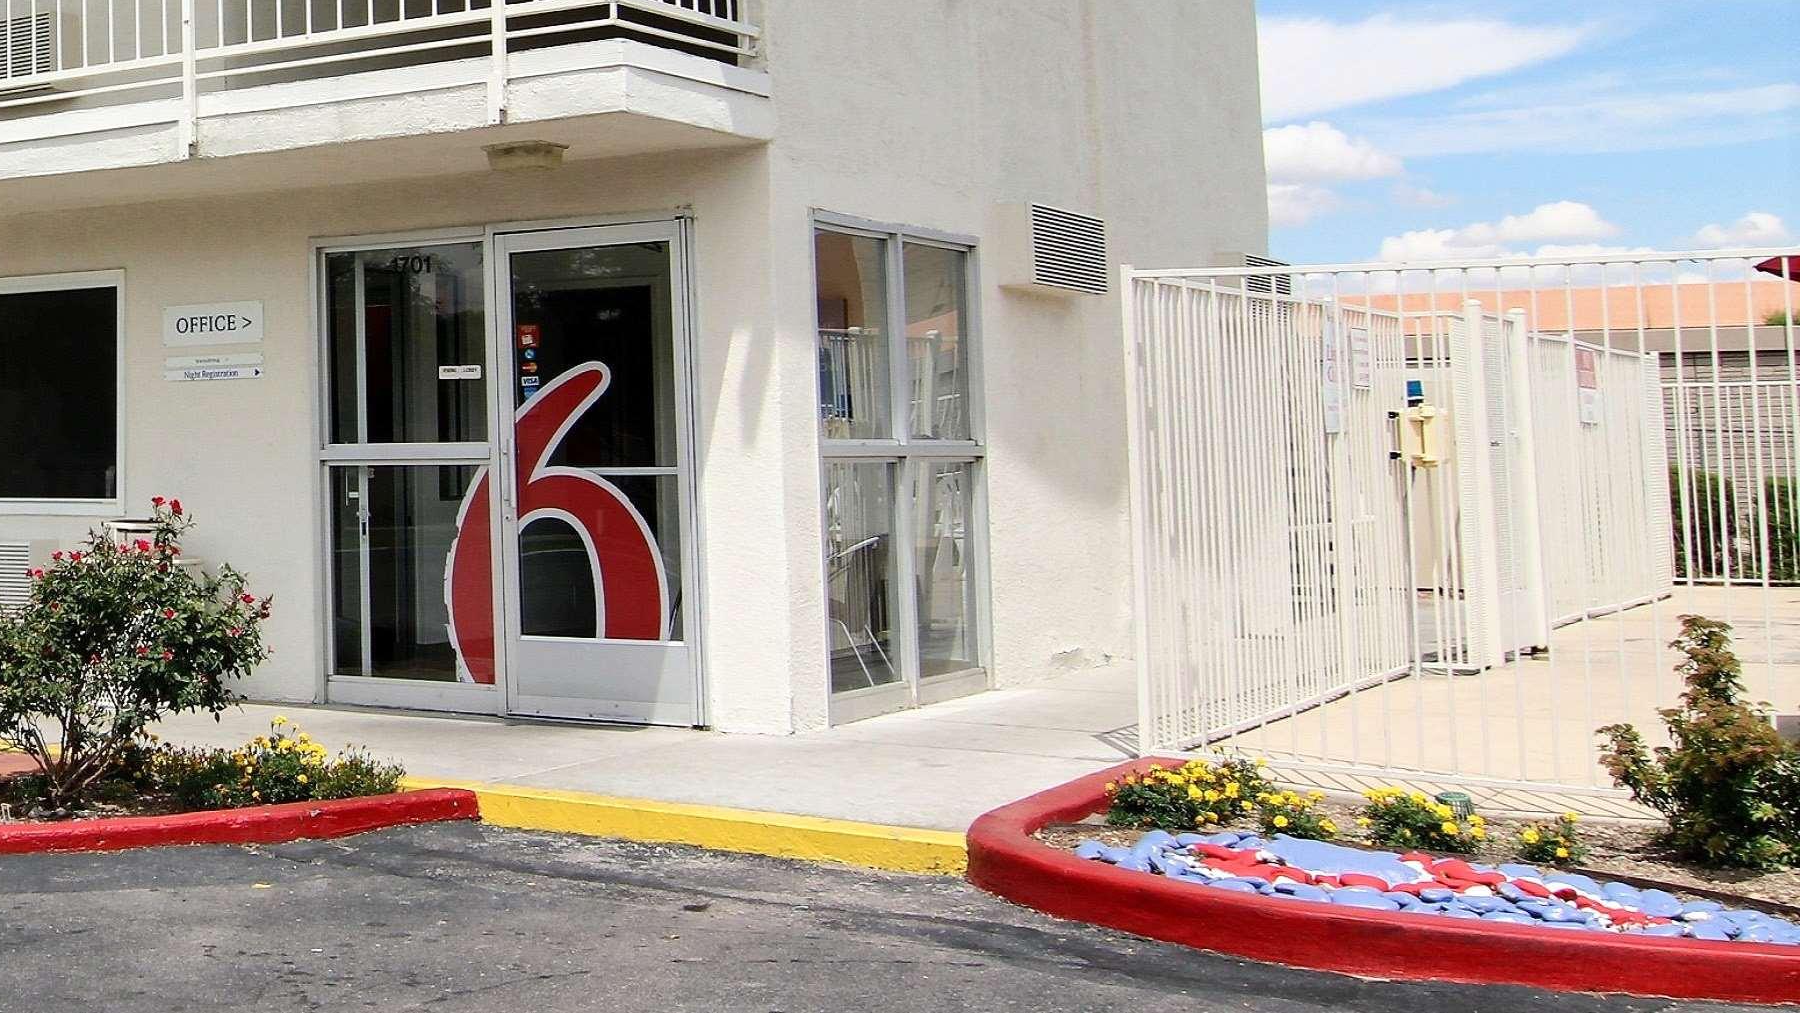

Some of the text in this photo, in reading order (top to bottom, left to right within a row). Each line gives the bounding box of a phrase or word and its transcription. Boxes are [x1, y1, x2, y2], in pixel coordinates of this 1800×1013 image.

[176, 314, 236, 334] OFFICE
[184, 369, 239, 381] Night Registration
[523, 377, 538, 385] VISA
